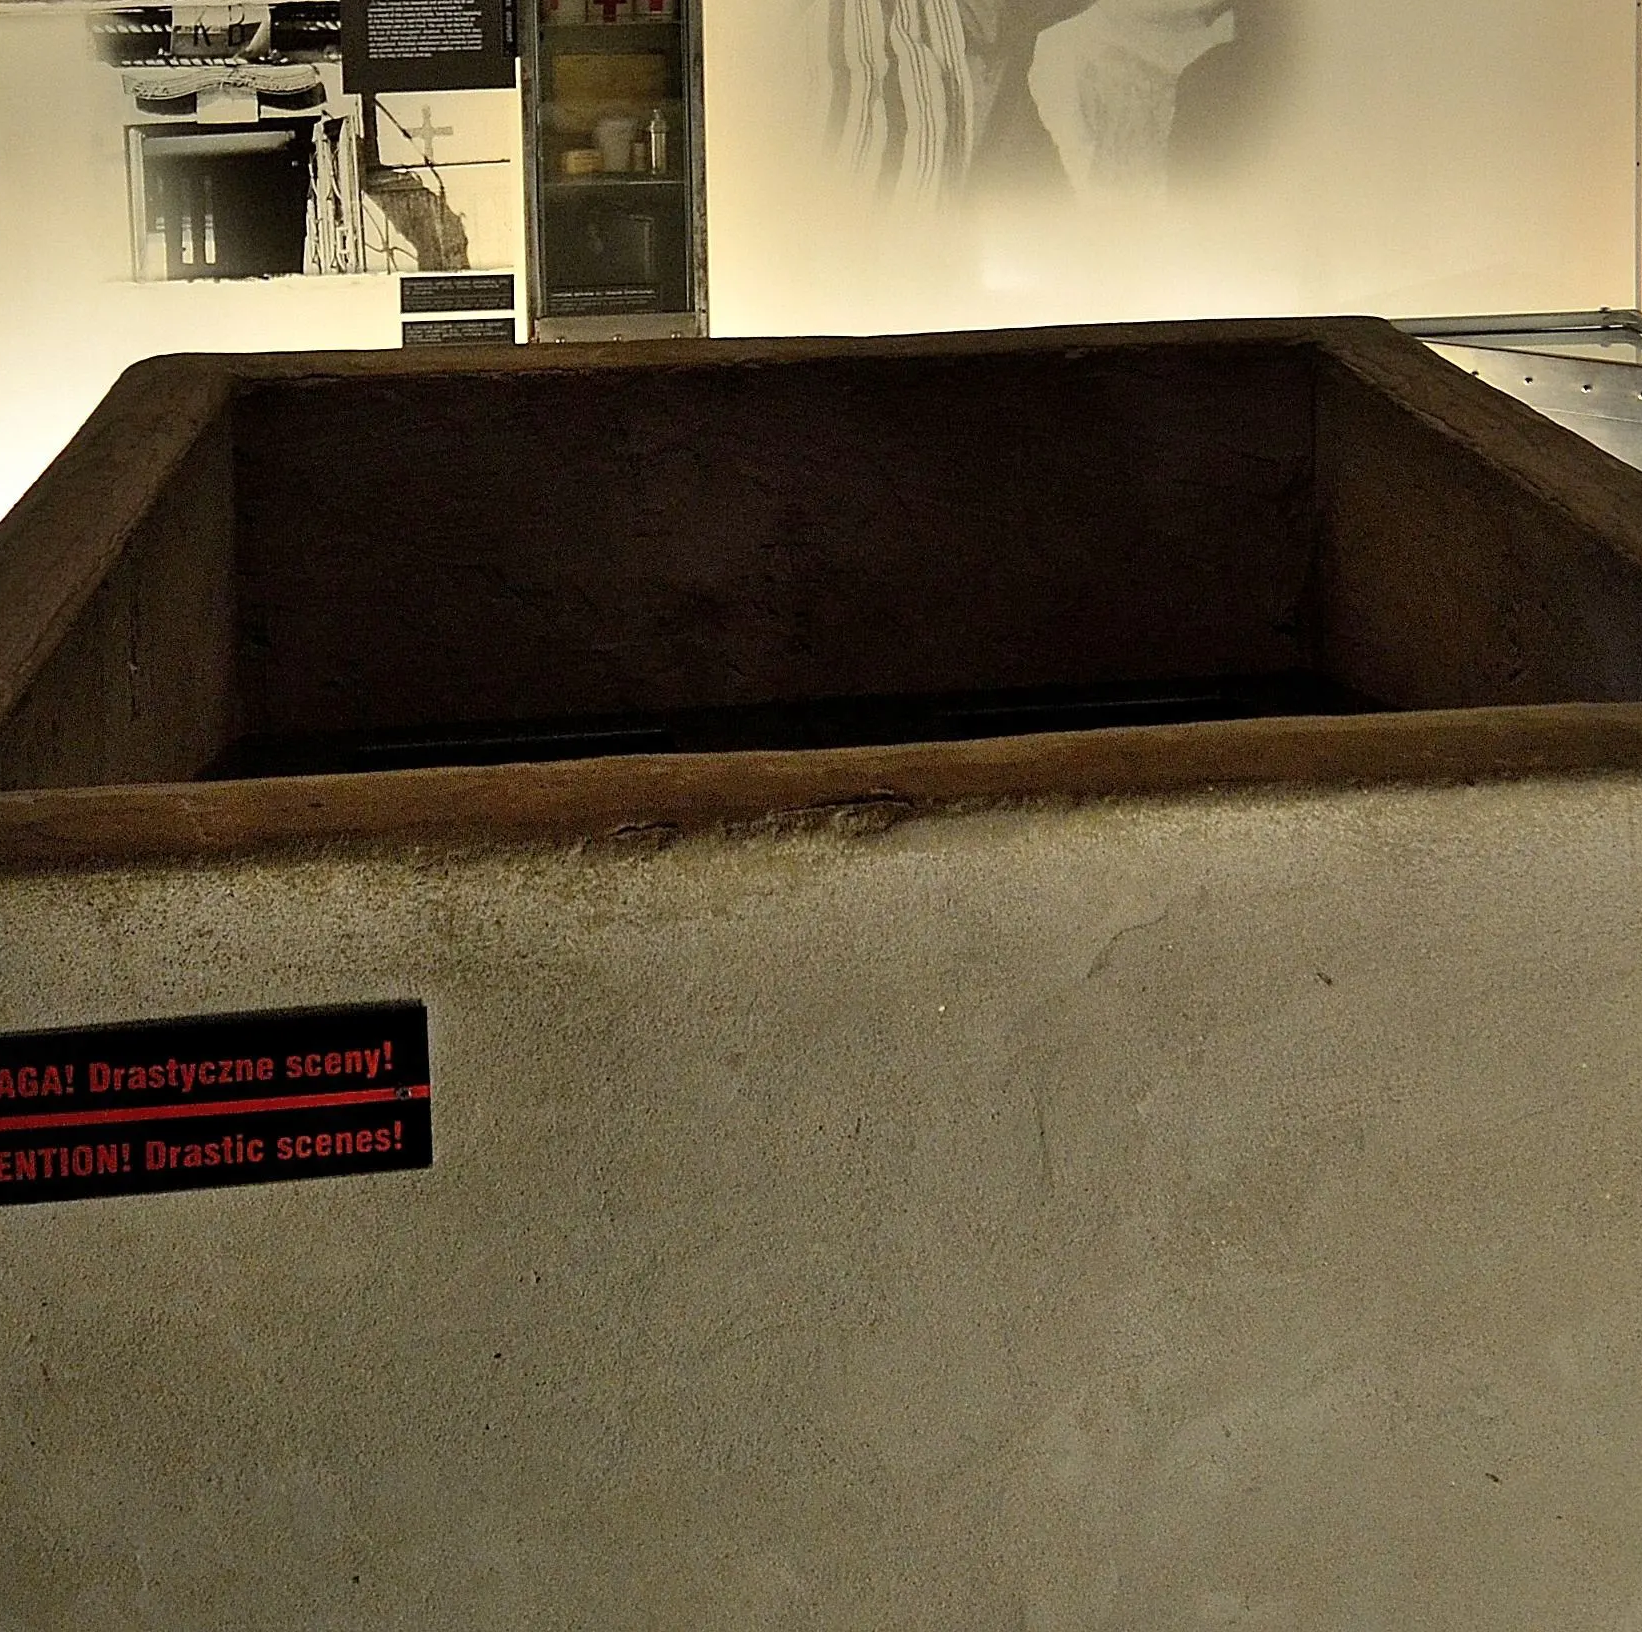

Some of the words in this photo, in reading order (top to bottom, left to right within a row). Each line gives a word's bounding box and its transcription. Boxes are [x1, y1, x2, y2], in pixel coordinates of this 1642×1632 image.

[88, 1053, 275, 1094] Drastyczne
[285, 1041, 394, 1081] sceny!
[145, 1132, 264, 1172] Drastic
[275, 1120, 404, 1160] scenes!
